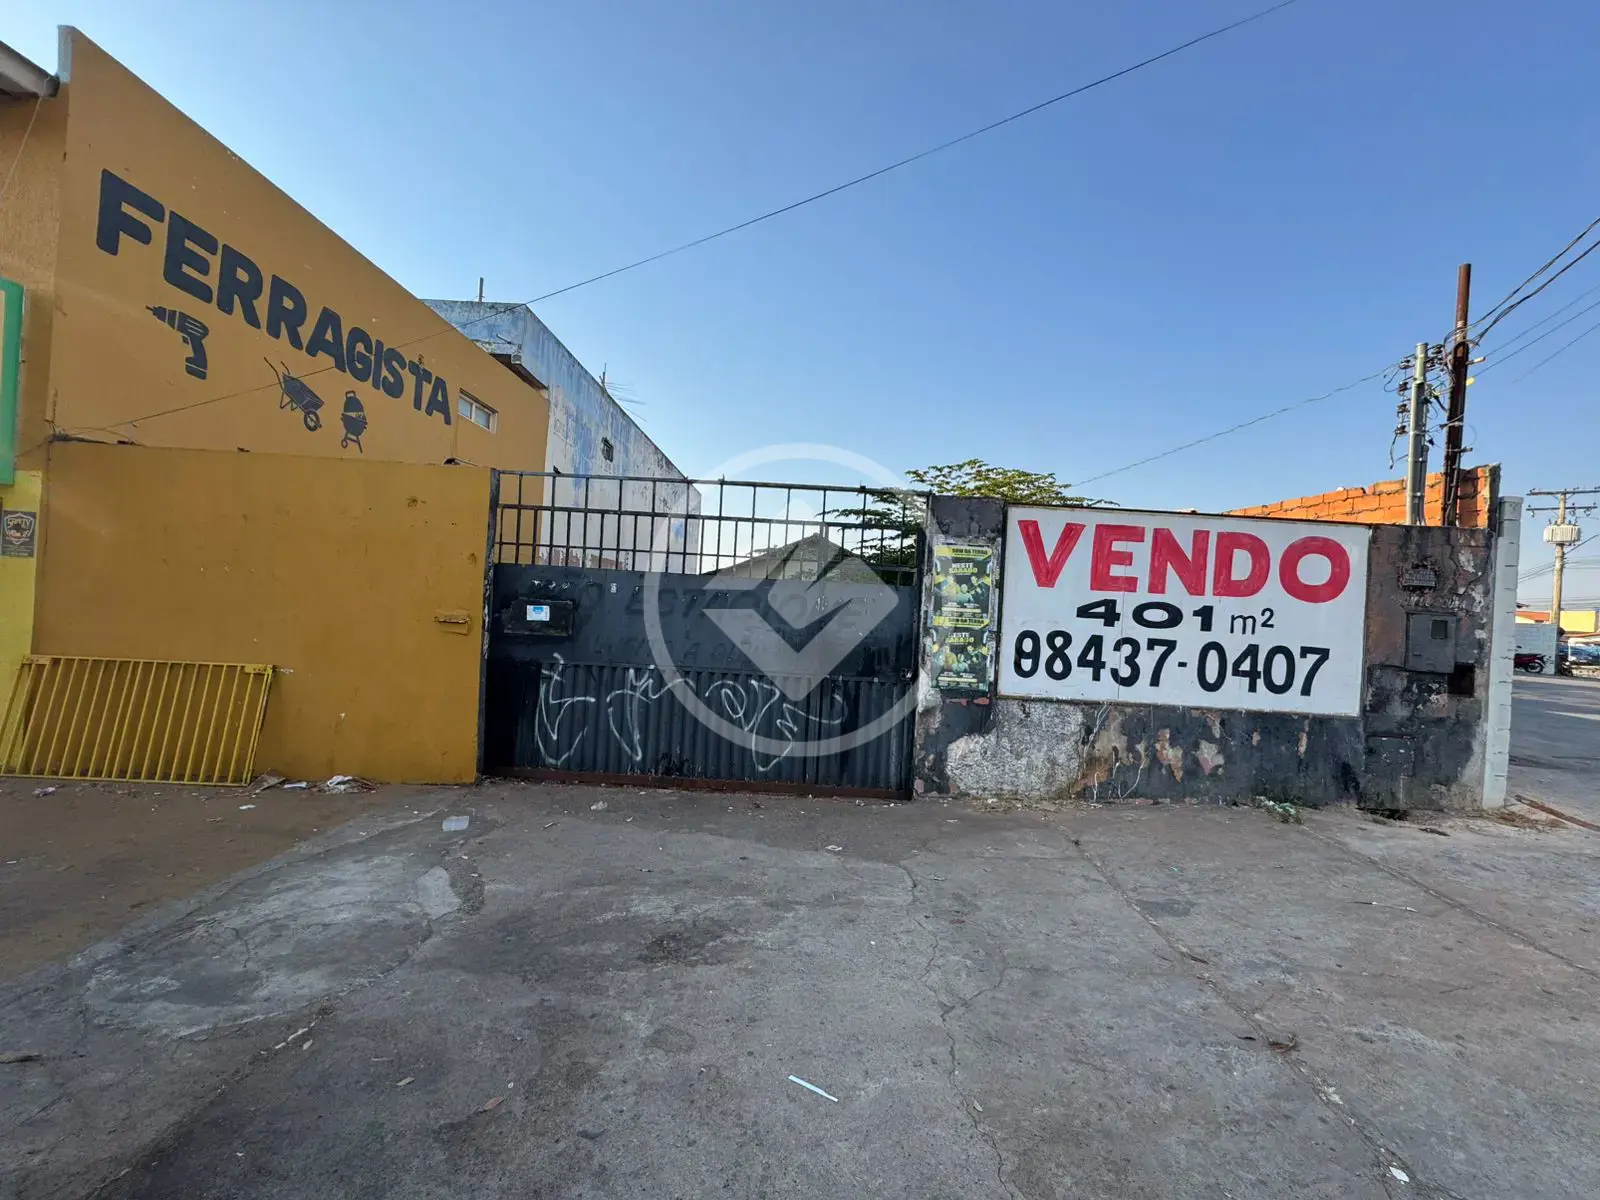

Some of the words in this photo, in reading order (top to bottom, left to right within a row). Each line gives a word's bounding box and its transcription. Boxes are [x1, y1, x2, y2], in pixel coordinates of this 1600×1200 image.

[96, 168, 452, 426] FERRAGISTA
[1018, 520, 1350, 603] VENDO
[1076, 599, 1214, 632] 401
